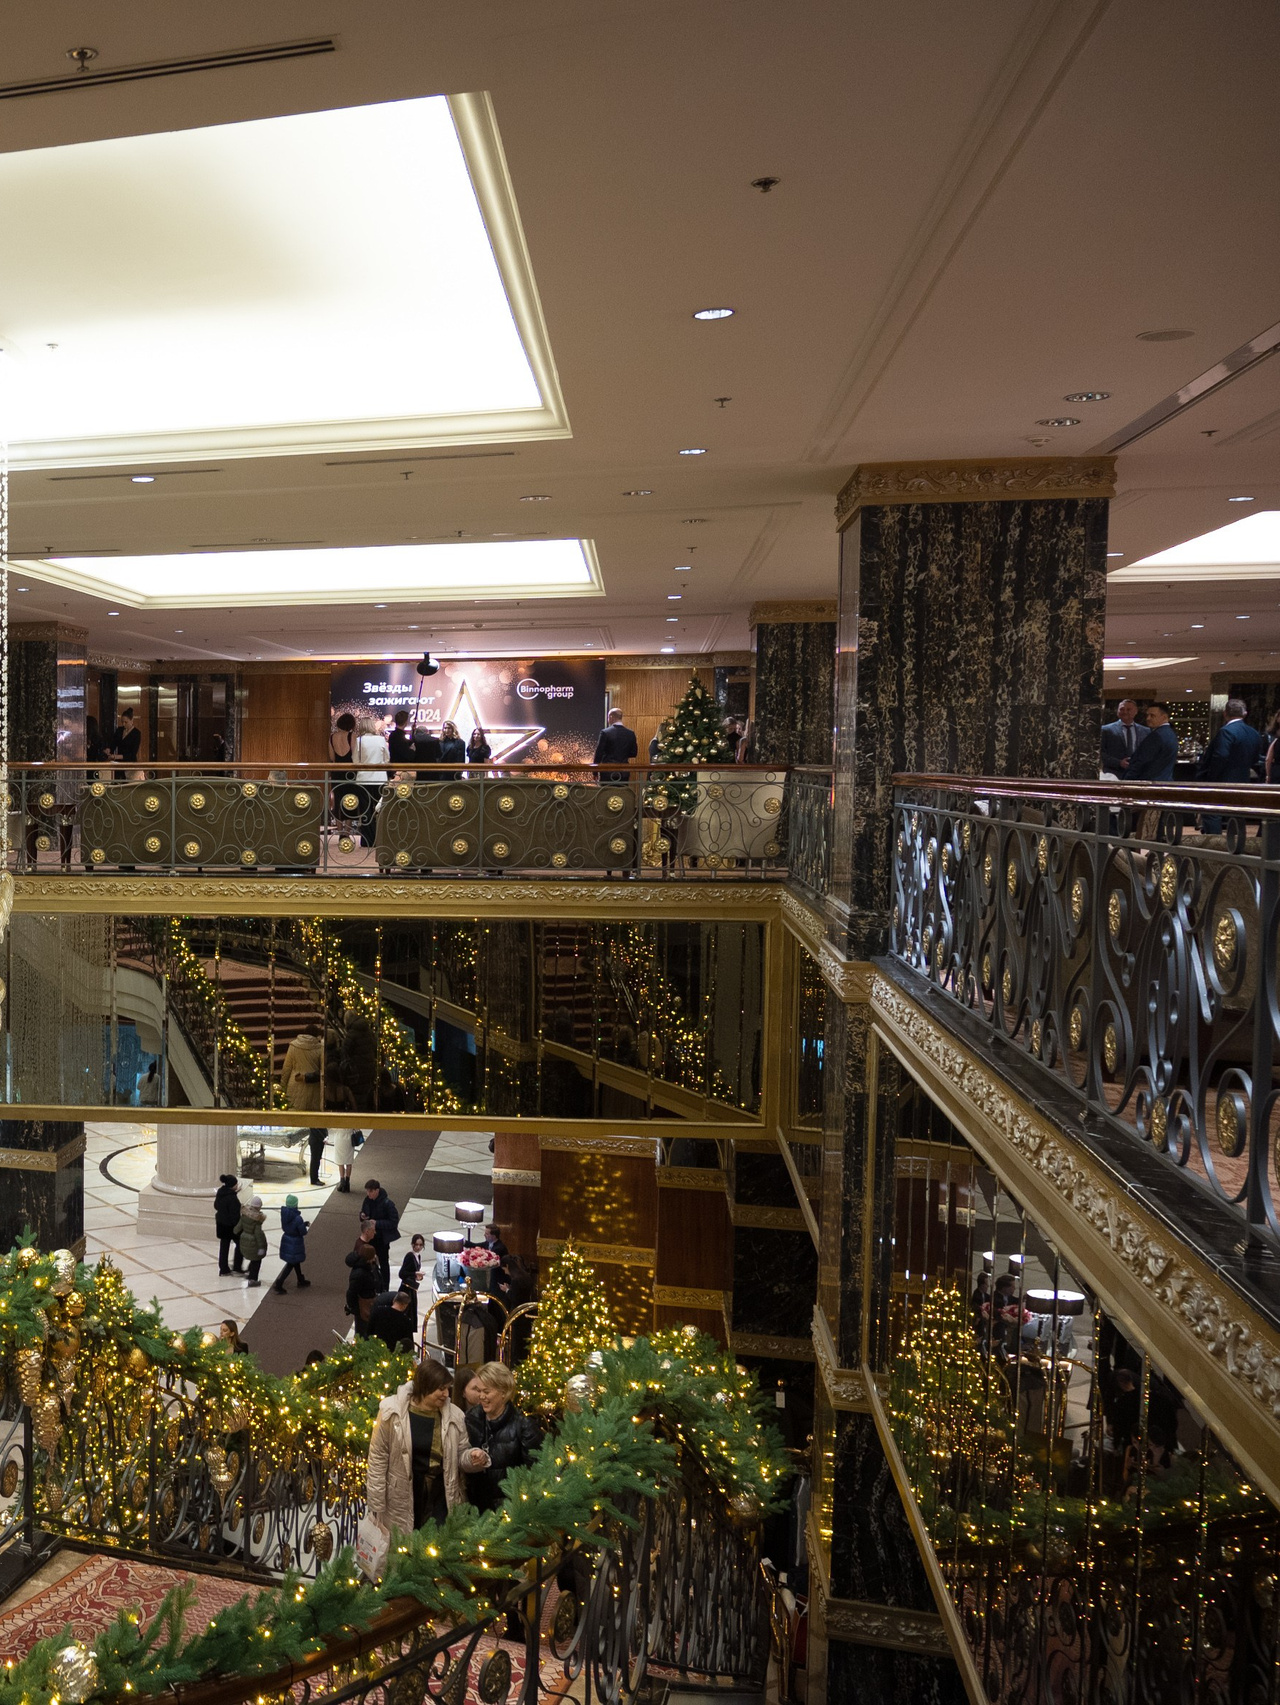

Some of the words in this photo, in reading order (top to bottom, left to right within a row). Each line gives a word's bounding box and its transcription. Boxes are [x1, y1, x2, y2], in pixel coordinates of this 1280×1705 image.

[362, 682, 413, 694] Звёзды
[520, 685, 574, 694] Binnopharm
[547, 692, 574, 700] group
[409, 708, 442, 723] 2024
